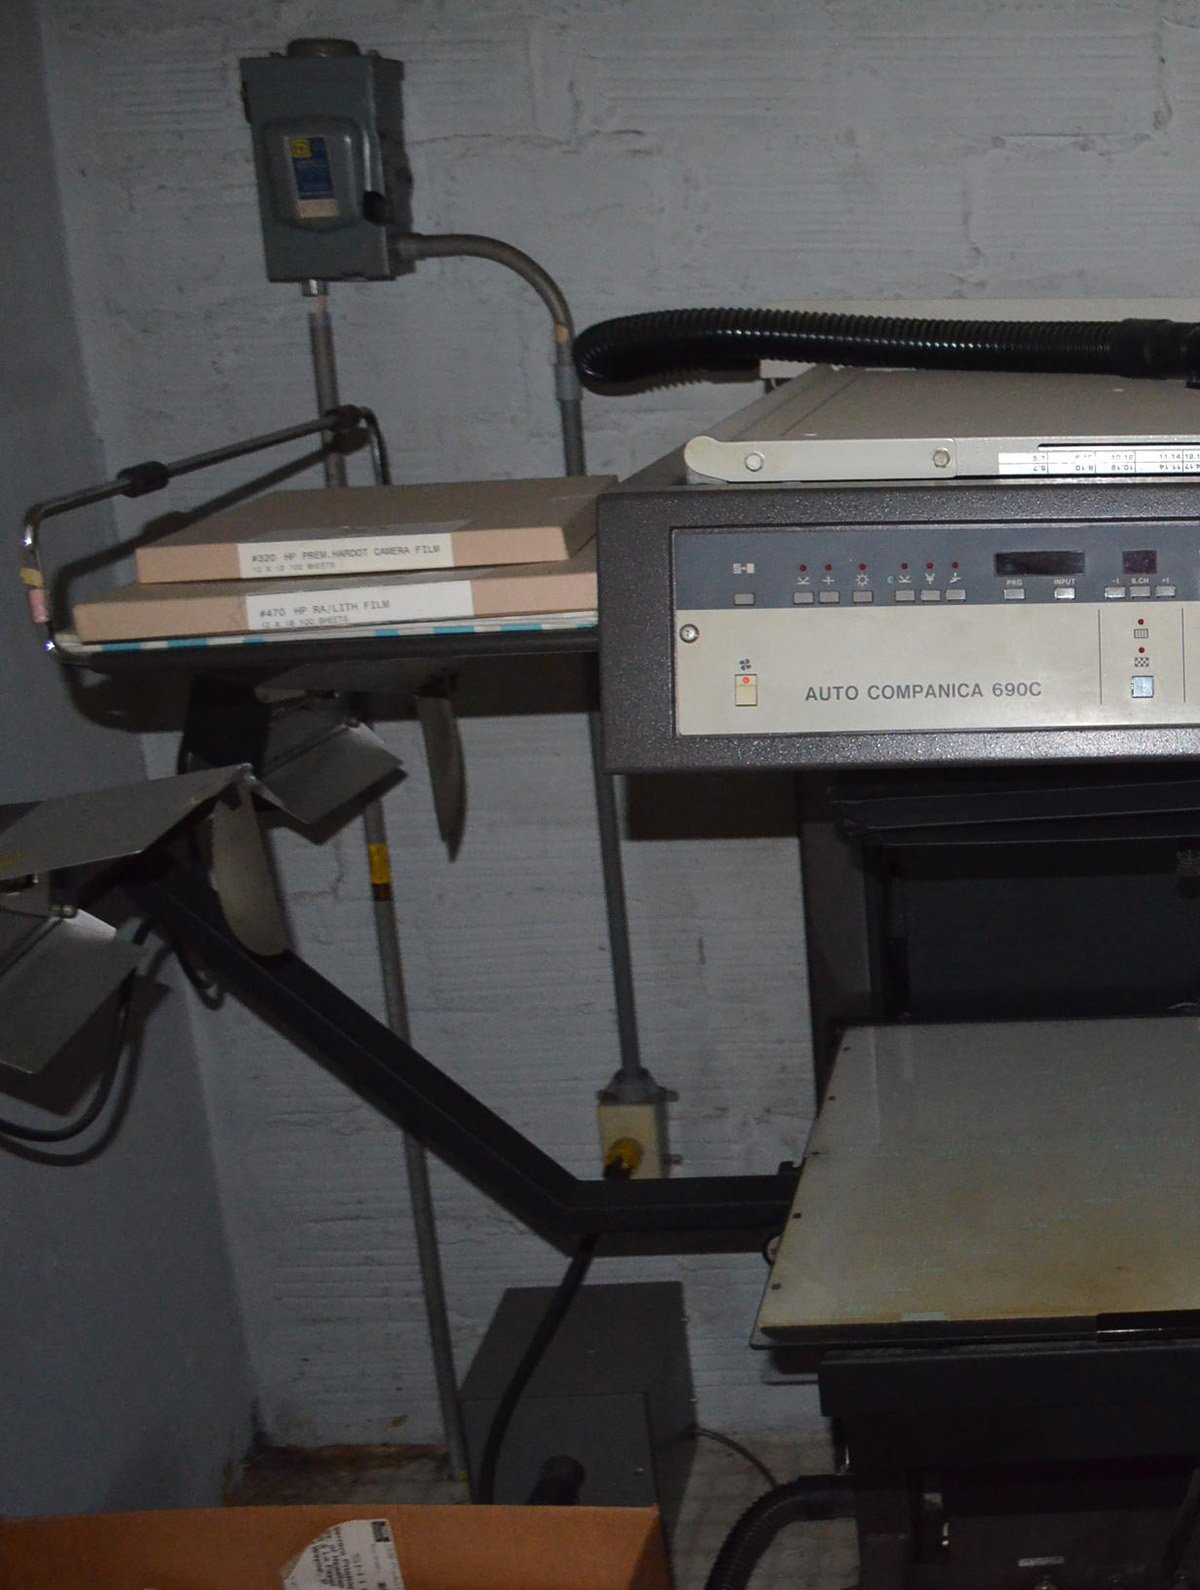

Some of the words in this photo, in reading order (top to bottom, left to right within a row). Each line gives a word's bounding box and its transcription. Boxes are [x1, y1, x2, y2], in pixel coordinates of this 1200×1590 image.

[284, 553, 296, 561] HP
[374, 546, 410, 556] CAMERA
[415, 544, 441, 554] FILM
[1053, 577, 1076, 585] INPUT
[294, 606, 306, 616] HP
[363, 599, 391, 610] FILM
[805, 685, 859, 702] AUTO
[867, 682, 984, 701] COMPANICA
[992, 681, 1042, 698] 690C
